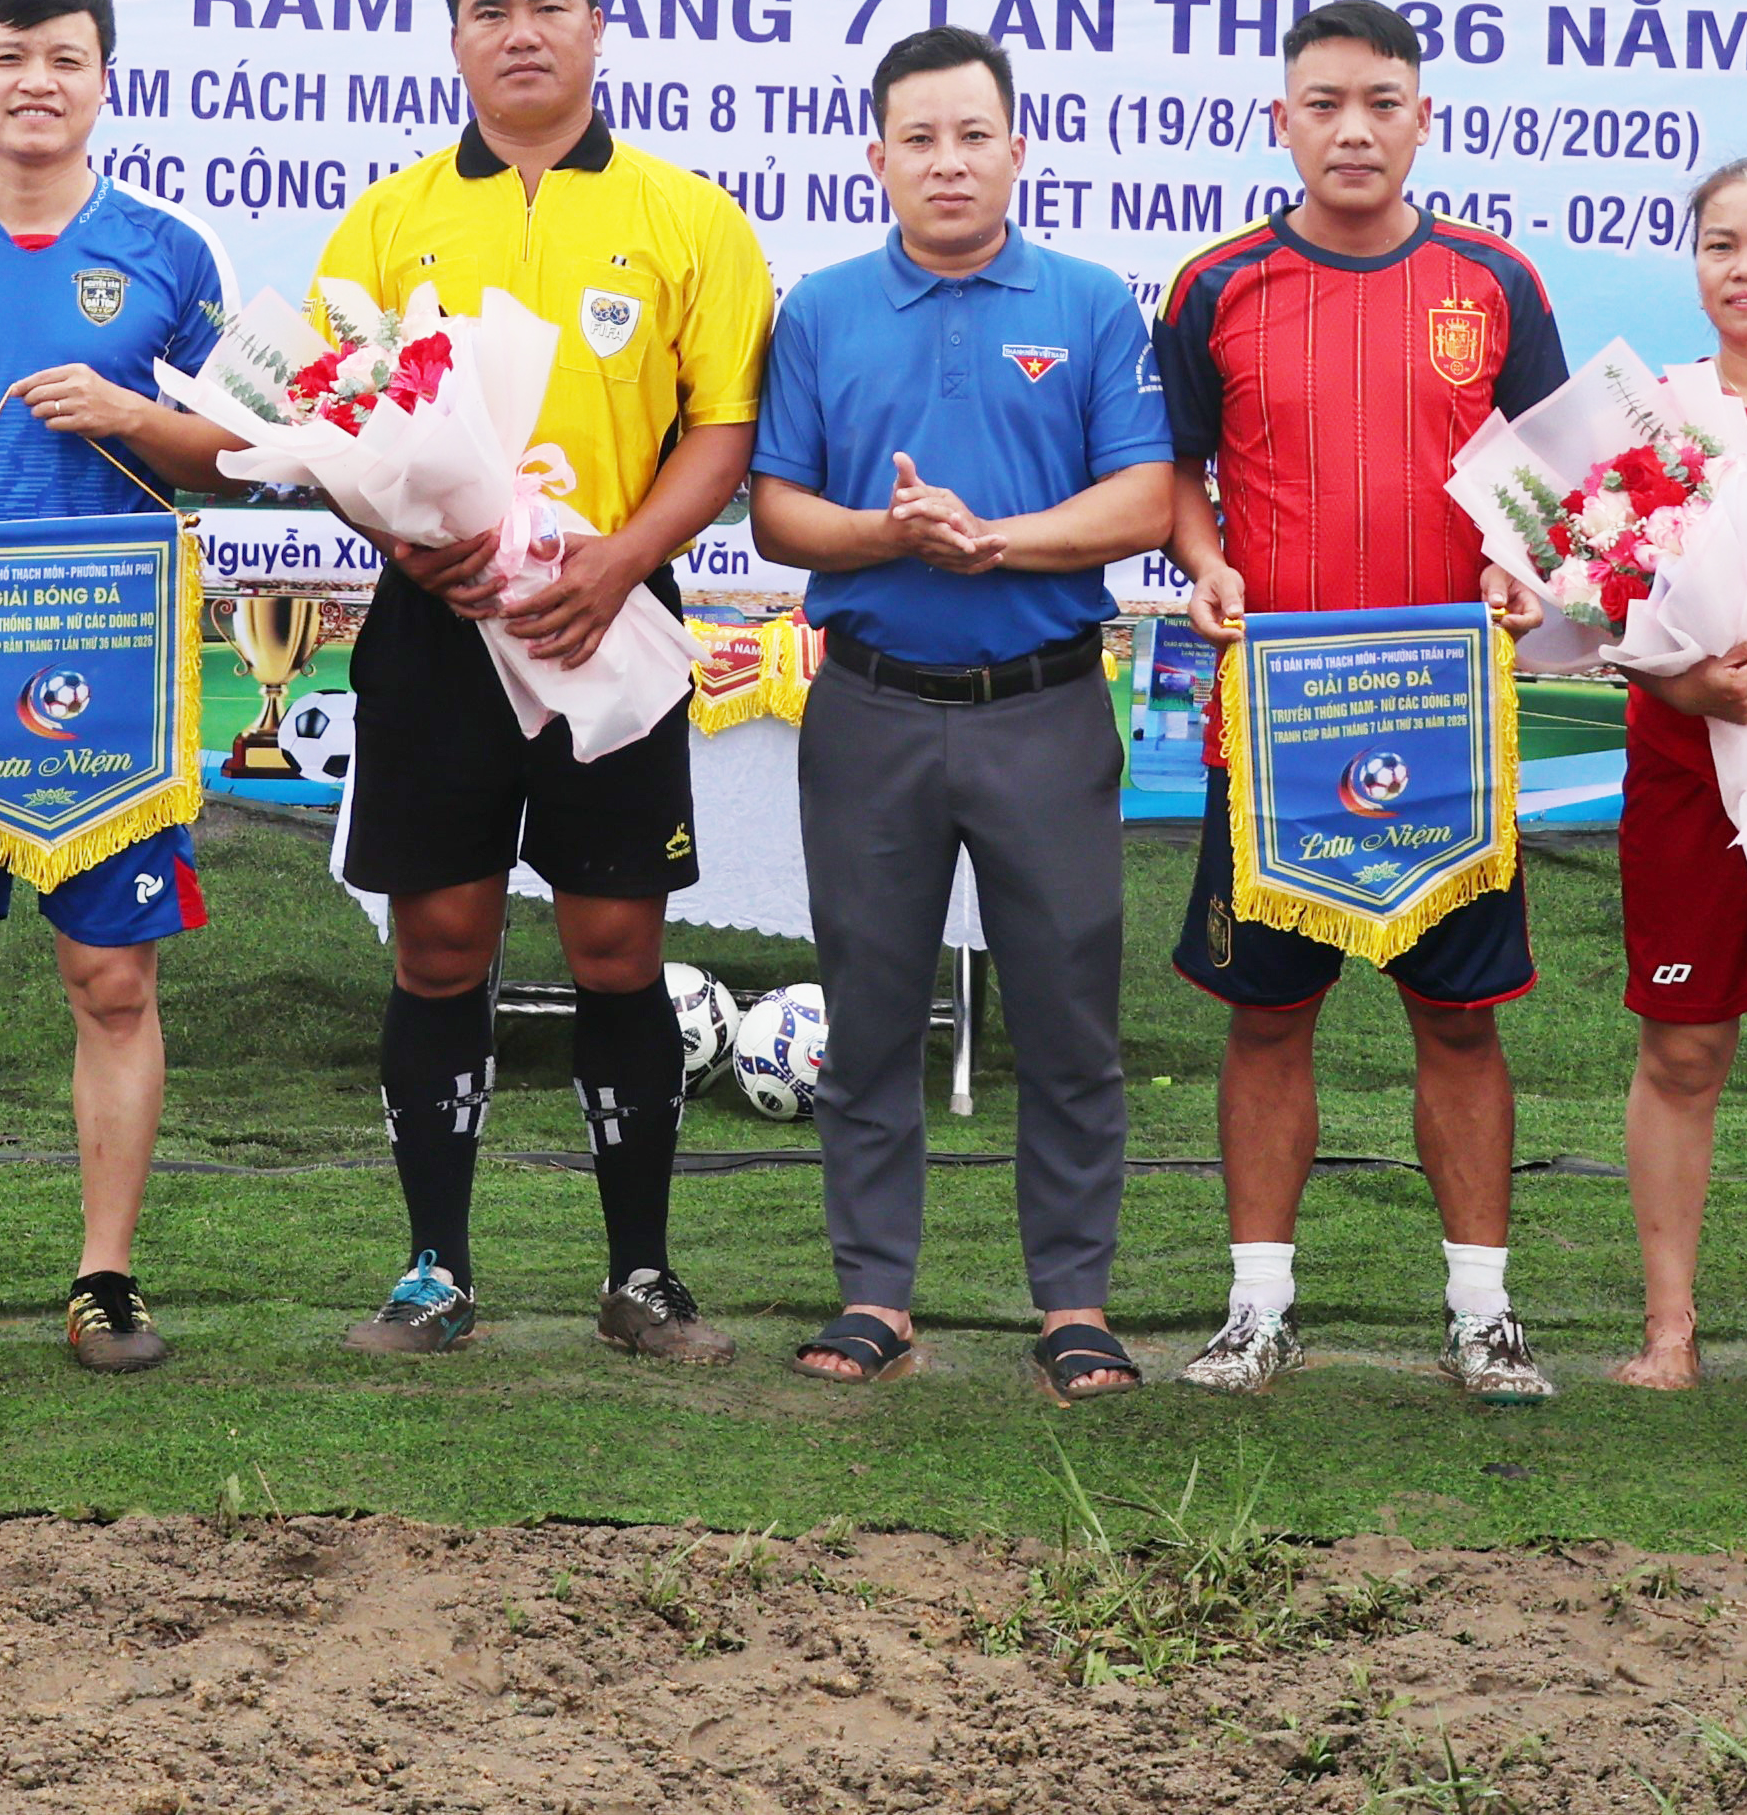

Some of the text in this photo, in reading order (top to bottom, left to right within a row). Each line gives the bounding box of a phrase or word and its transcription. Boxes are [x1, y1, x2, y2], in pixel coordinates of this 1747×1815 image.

[107, 57, 169, 117] ĂM
[192, 60, 325, 121] CÁCH
[348, 75, 476, 137] MẠN
[710, 85, 735, 132] 8
[756, 71, 881, 136] THÀN
[1429, 100, 1699, 170] 19/8/2026)
[206, 147, 345, 219] CỘNG
[1020, 168, 1092, 239] IỆT
[1112, 183, 1221, 232] NAM
[591, 321, 623, 341] FIFA
[688, 541, 749, 575] Văn
[34, 584, 88, 605] BÓNG
[94, 583, 120, 603] ĐÁ
[1304, 666, 1433, 697] GIẢI BÓNG ĐÁ
[37, 747, 134, 777] Niệm
[1299, 824, 1452, 860] Lưu Niệm
